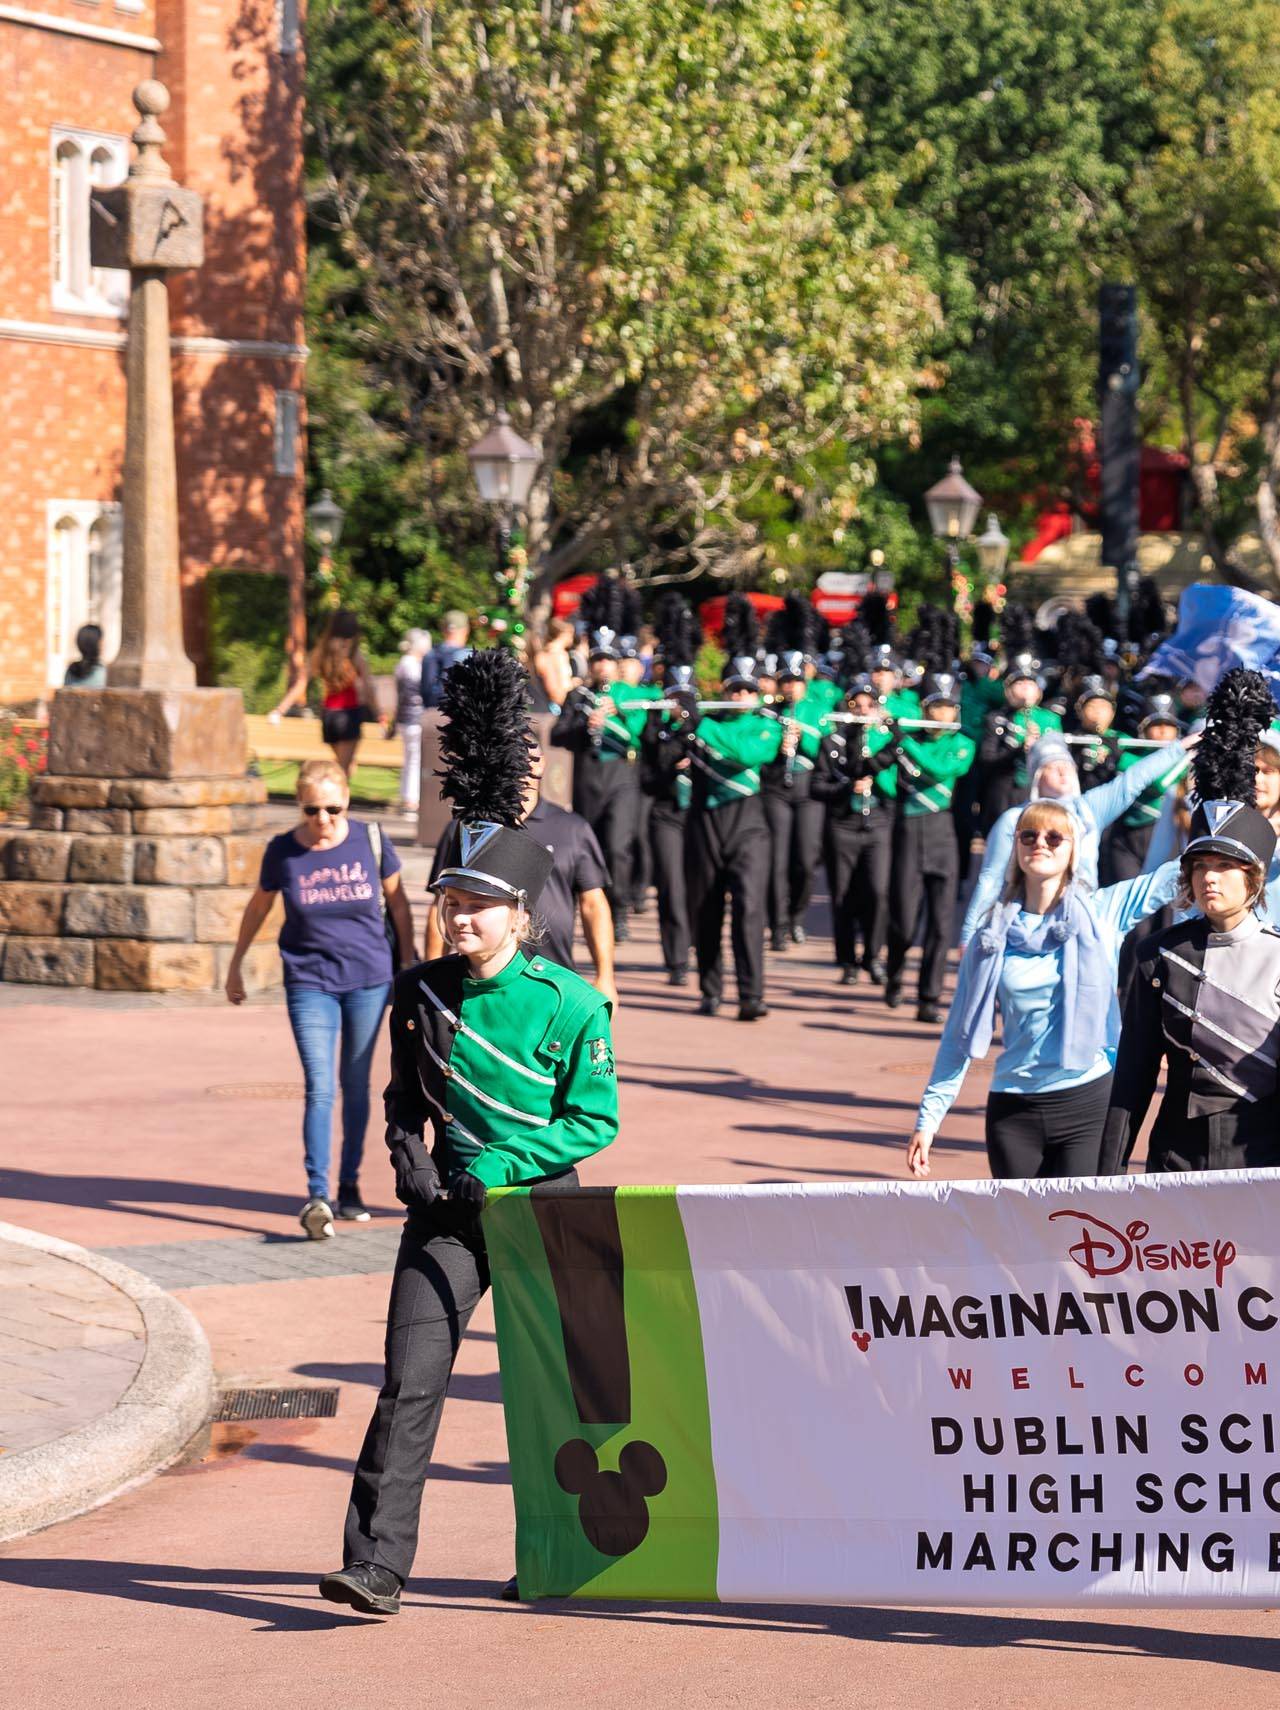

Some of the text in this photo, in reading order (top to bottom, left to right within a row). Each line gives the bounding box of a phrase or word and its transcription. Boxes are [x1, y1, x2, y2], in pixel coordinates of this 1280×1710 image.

[931, 1415, 1149, 1456] DUBLIN
[963, 1474, 1103, 1513] HIGH
[916, 1531, 1235, 1572] MARCHING
